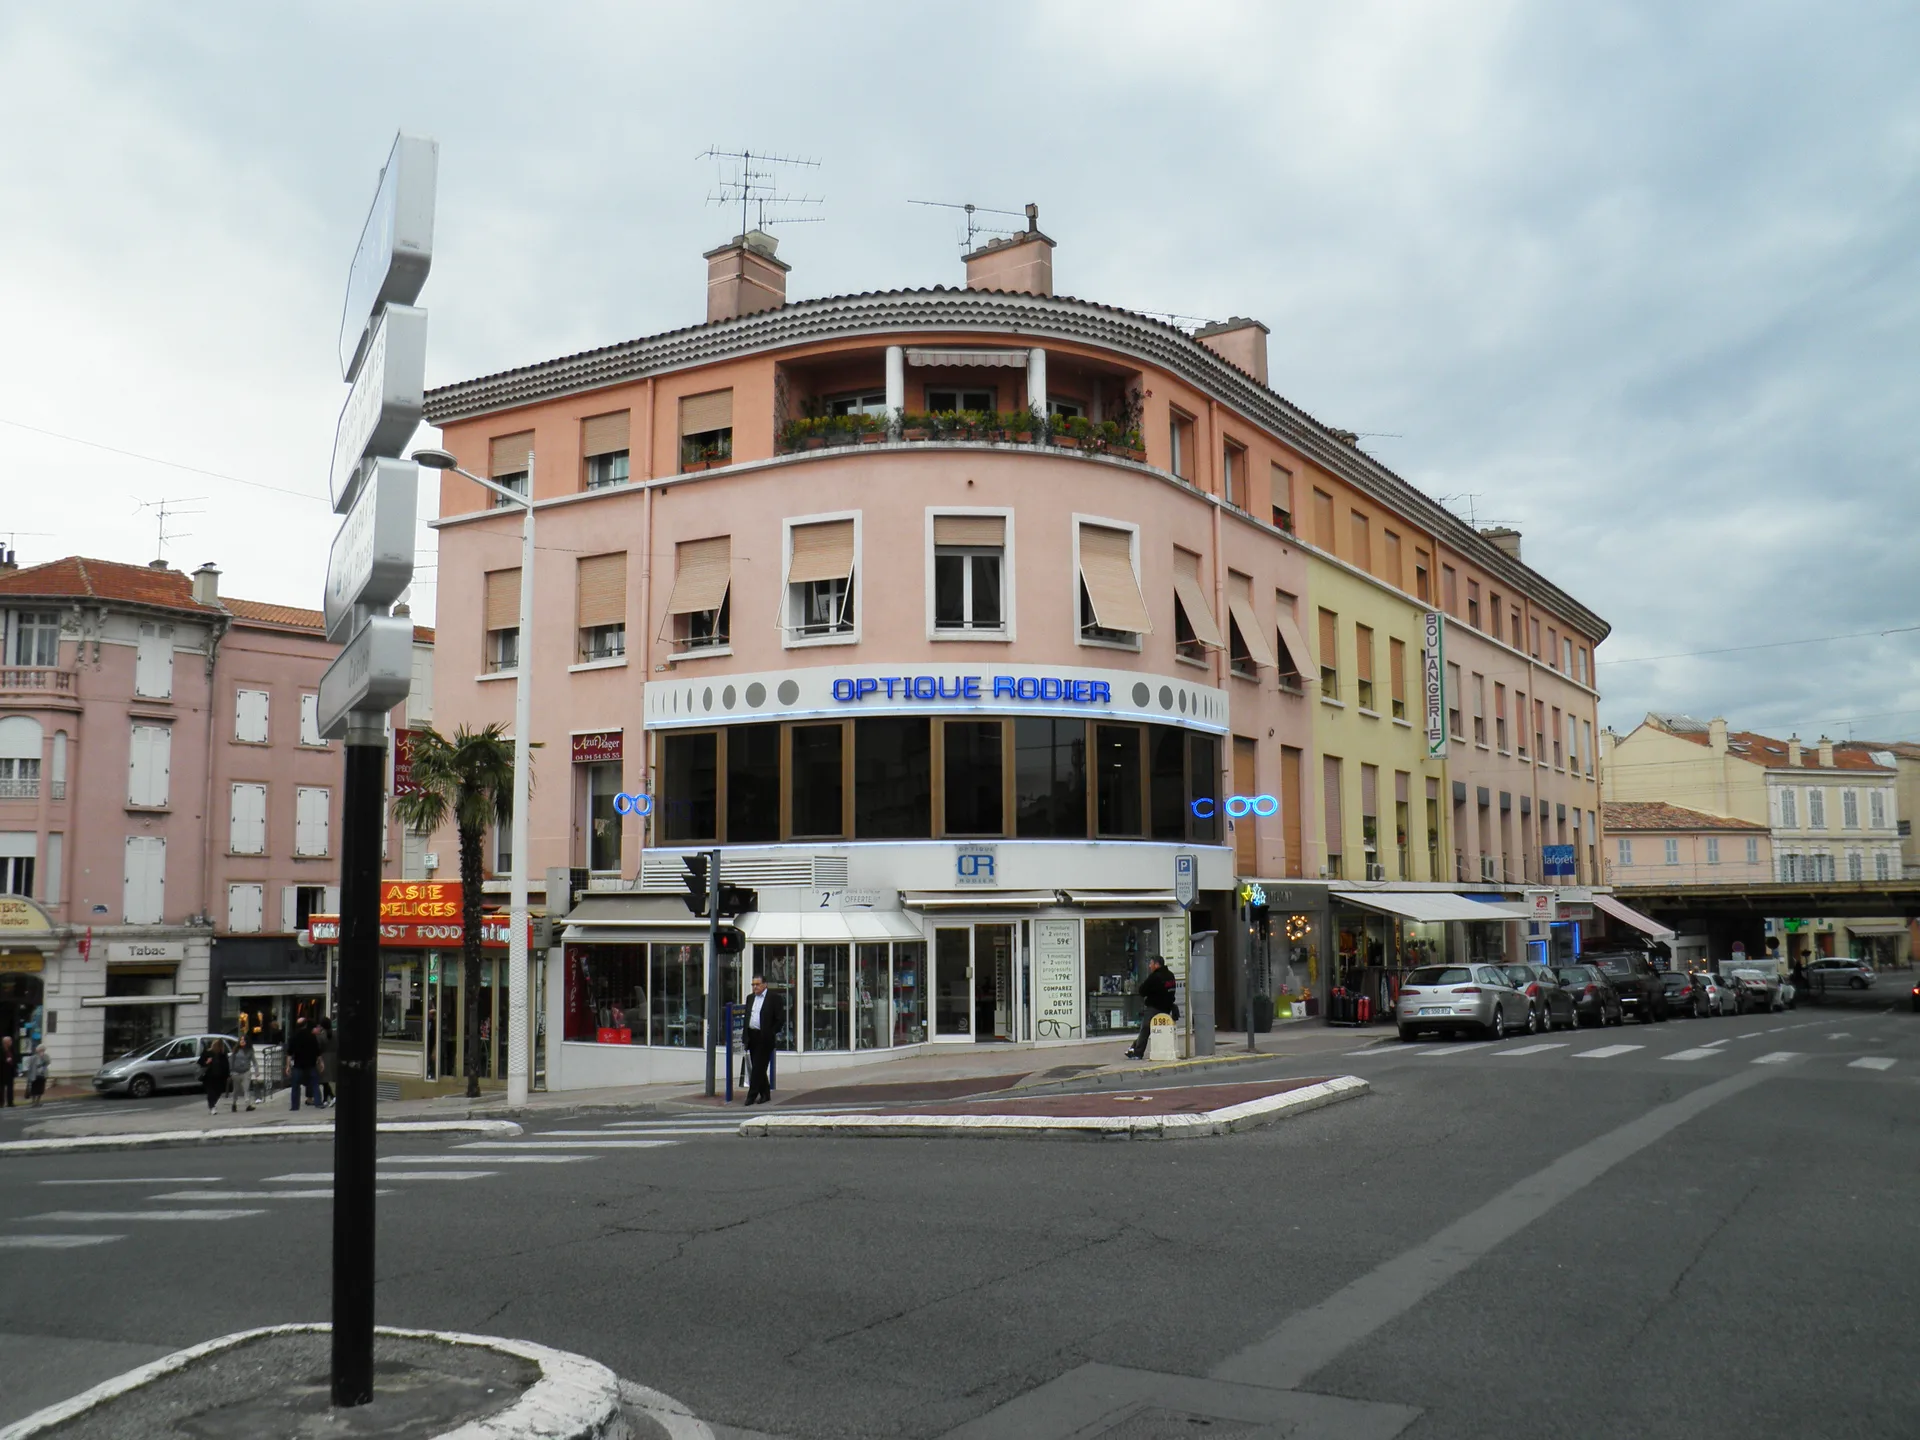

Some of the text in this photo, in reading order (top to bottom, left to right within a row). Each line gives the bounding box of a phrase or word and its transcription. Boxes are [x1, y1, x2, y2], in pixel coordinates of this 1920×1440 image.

[1425, 613, 1441, 741] BOULANGERIE
[832, 675, 1112, 703] OPTIQUE RODIER
[573, 735, 598, 751] Azur
[957, 854, 995, 876] OR
[1543, 854, 1573, 865] laforêt
[387, 884, 444, 900] ASIE
[380, 925, 463, 939] AST FOOD
[128, 946, 166, 957] Tabac
[1053, 999, 1073, 1007] DEVIS
